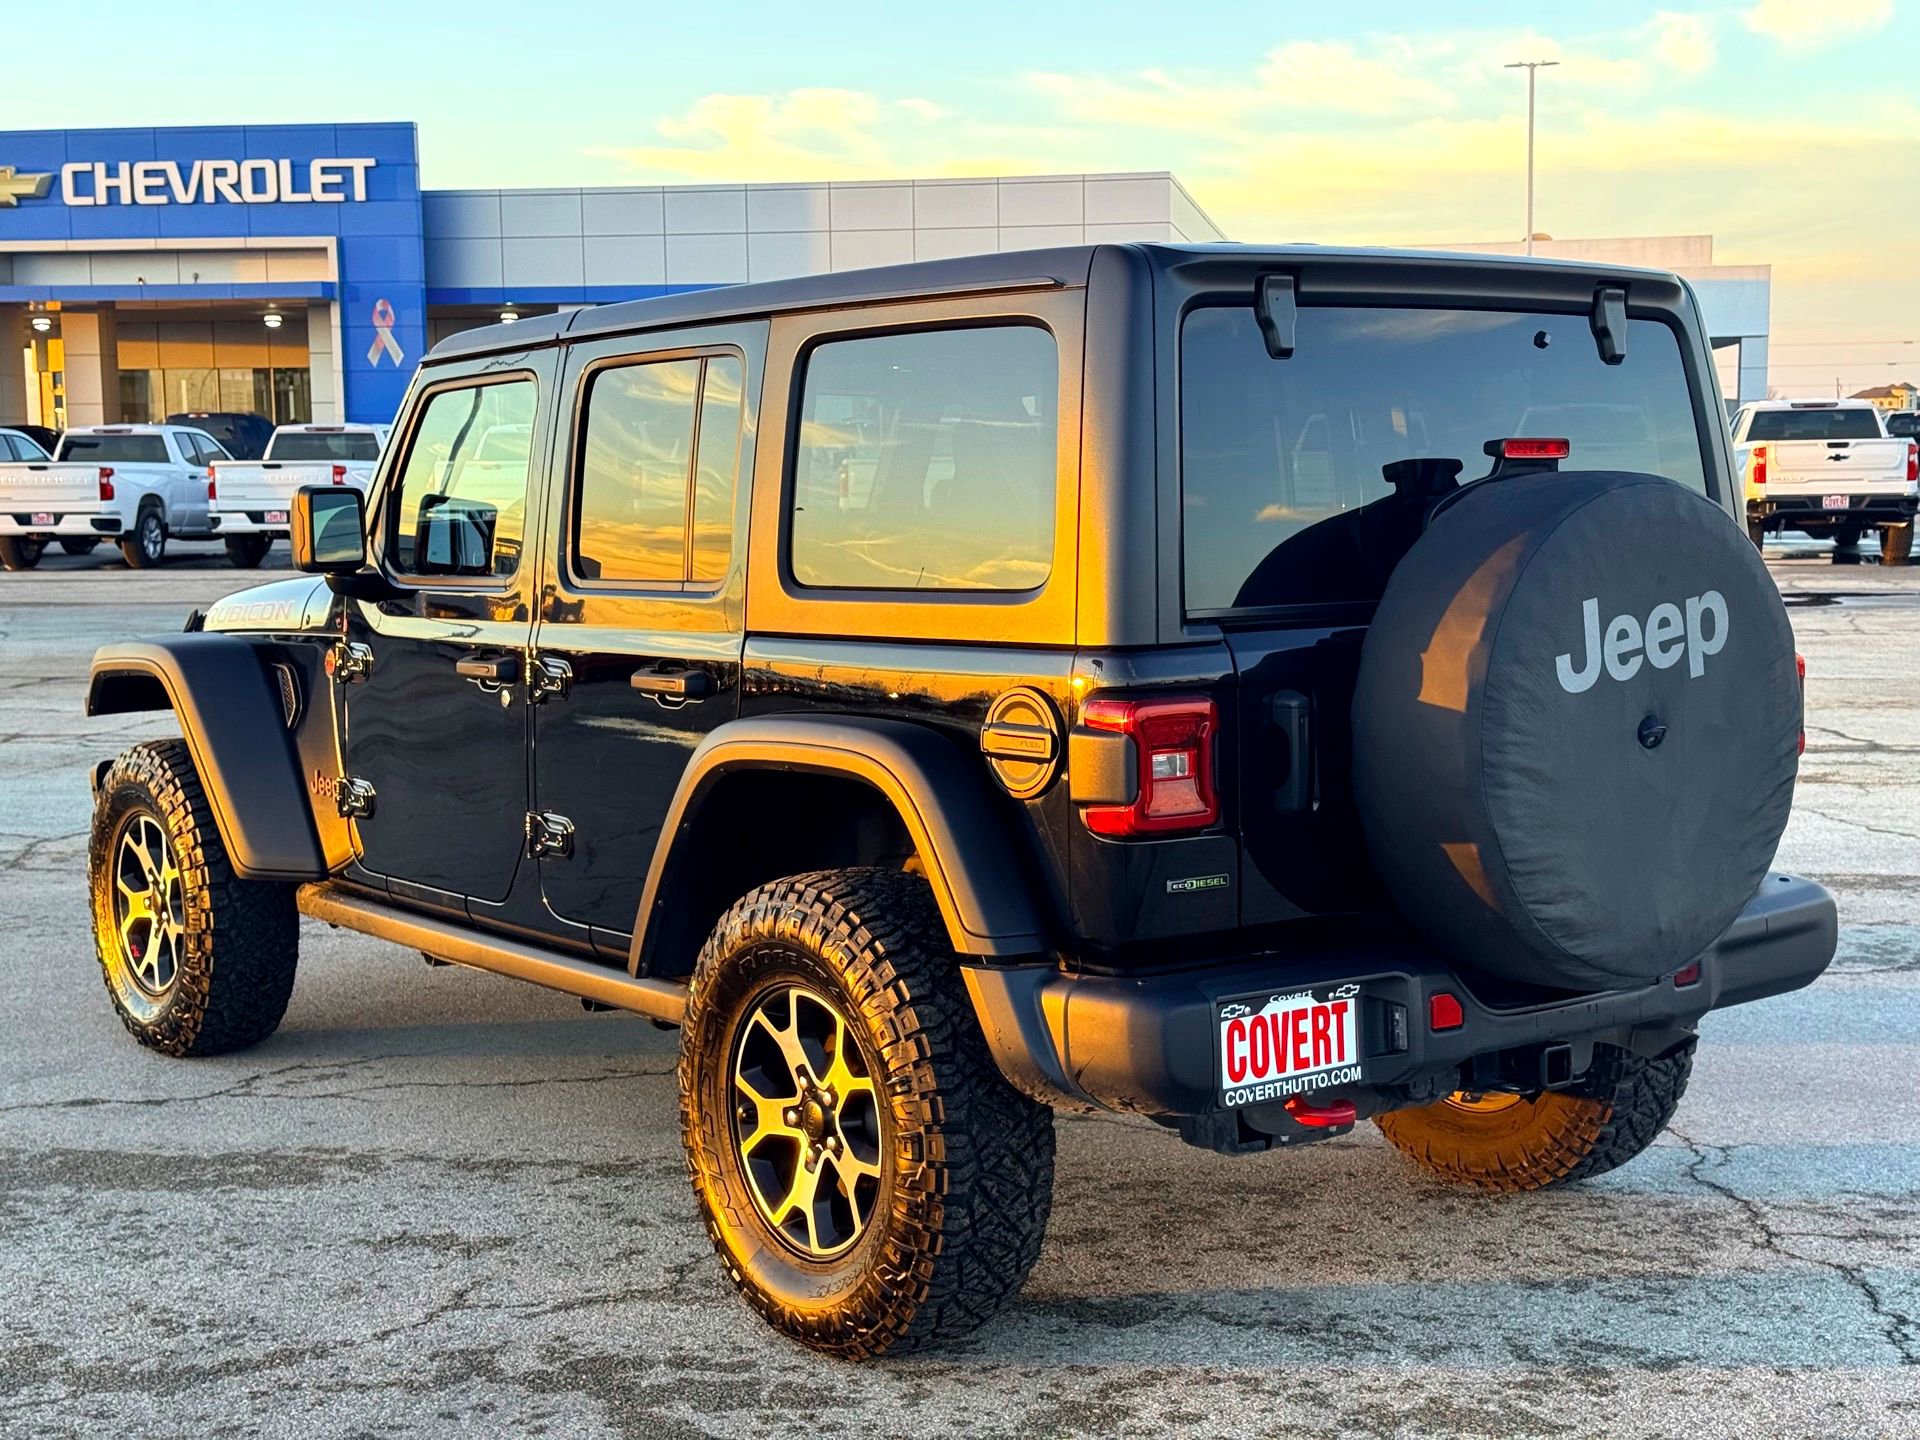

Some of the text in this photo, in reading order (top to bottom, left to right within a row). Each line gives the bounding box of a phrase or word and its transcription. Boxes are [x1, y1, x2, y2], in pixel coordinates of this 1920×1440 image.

[61, 157, 377, 206] CHEVROLET
[209, 600, 295, 624] RUBICON
[1555, 590, 1729, 694] Jeep
[1269, 989, 1313, 1003] Covert
[1226, 1001, 1348, 1084] COVERT
[1225, 1065, 1362, 1107] COVERTHUTTO.COM
